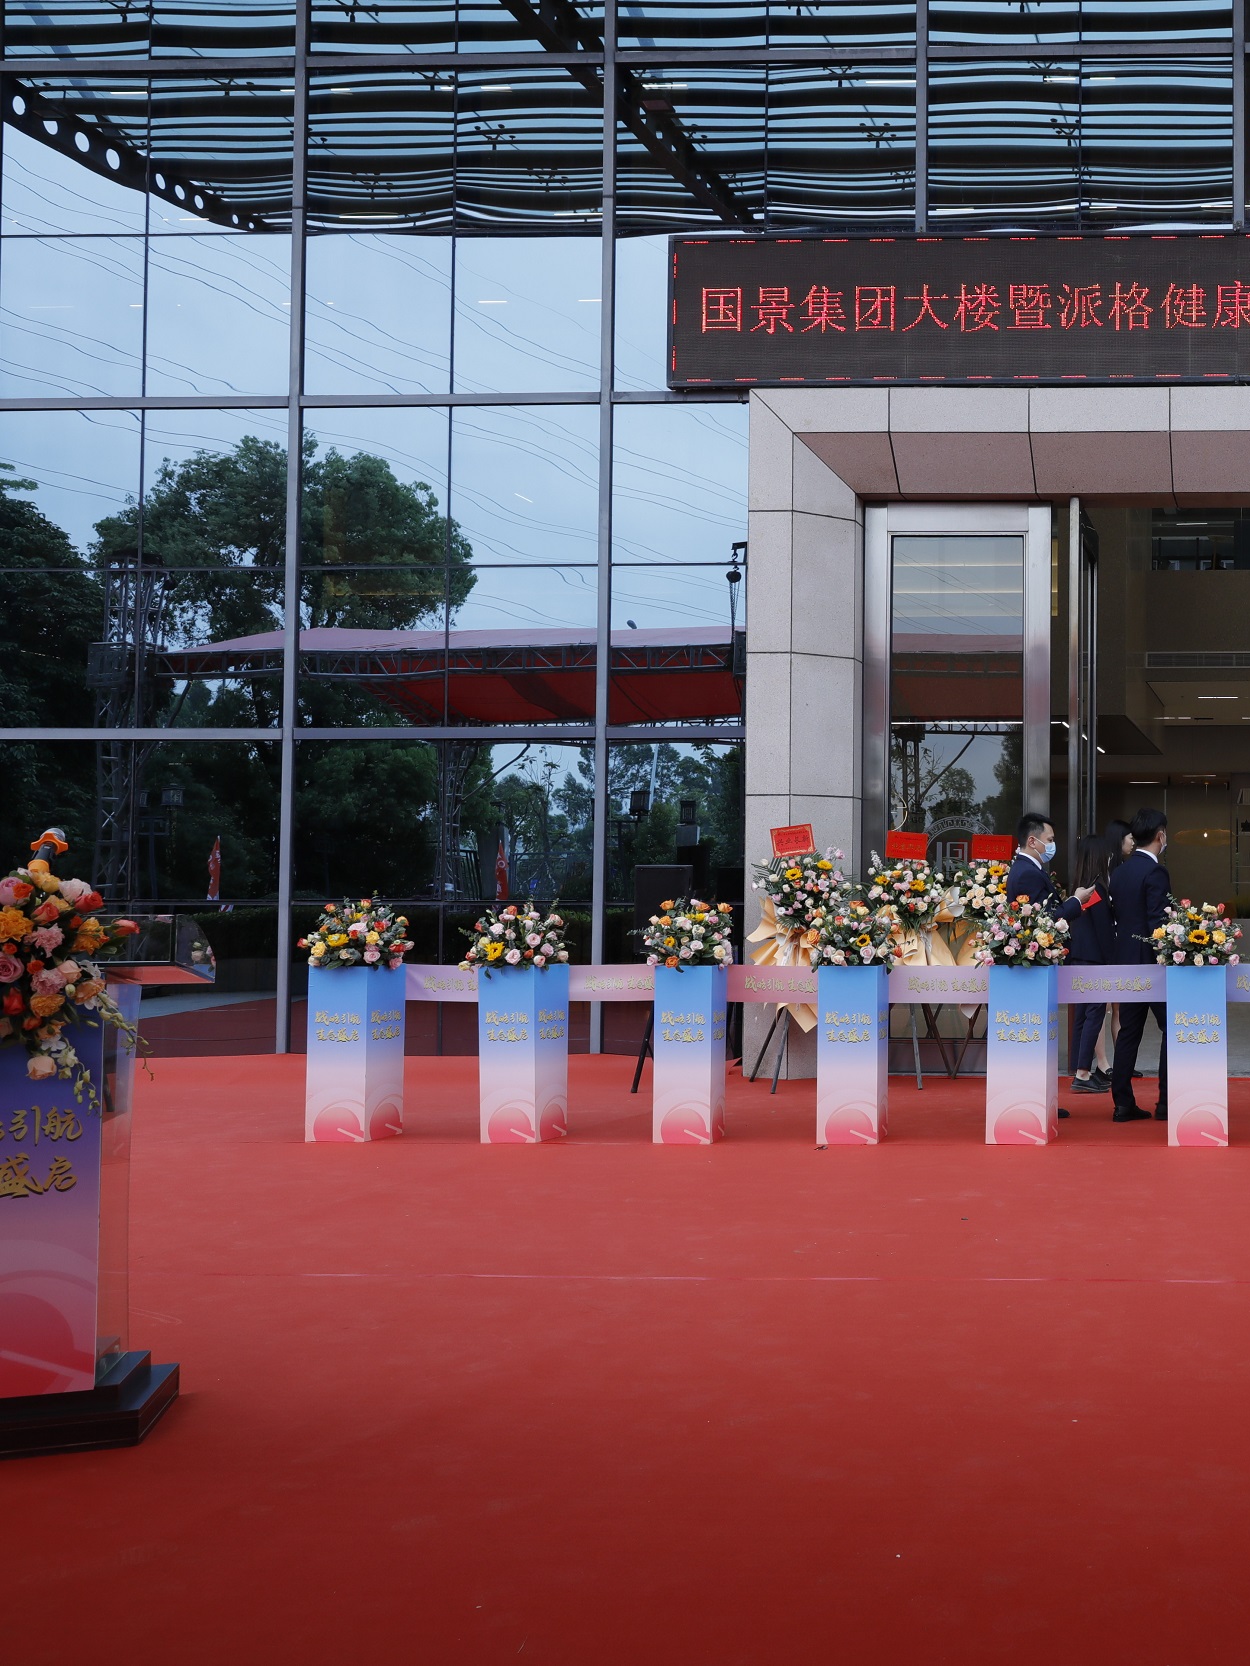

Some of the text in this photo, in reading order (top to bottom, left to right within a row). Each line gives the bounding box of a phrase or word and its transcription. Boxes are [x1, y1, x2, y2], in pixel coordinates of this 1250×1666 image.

[627, 975, 655, 990] 生态盛
[788, 977, 818, 993] 生态盛
[0, 1105, 83, 1147] 引航
[0, 1152, 78, 1198] 盛启
